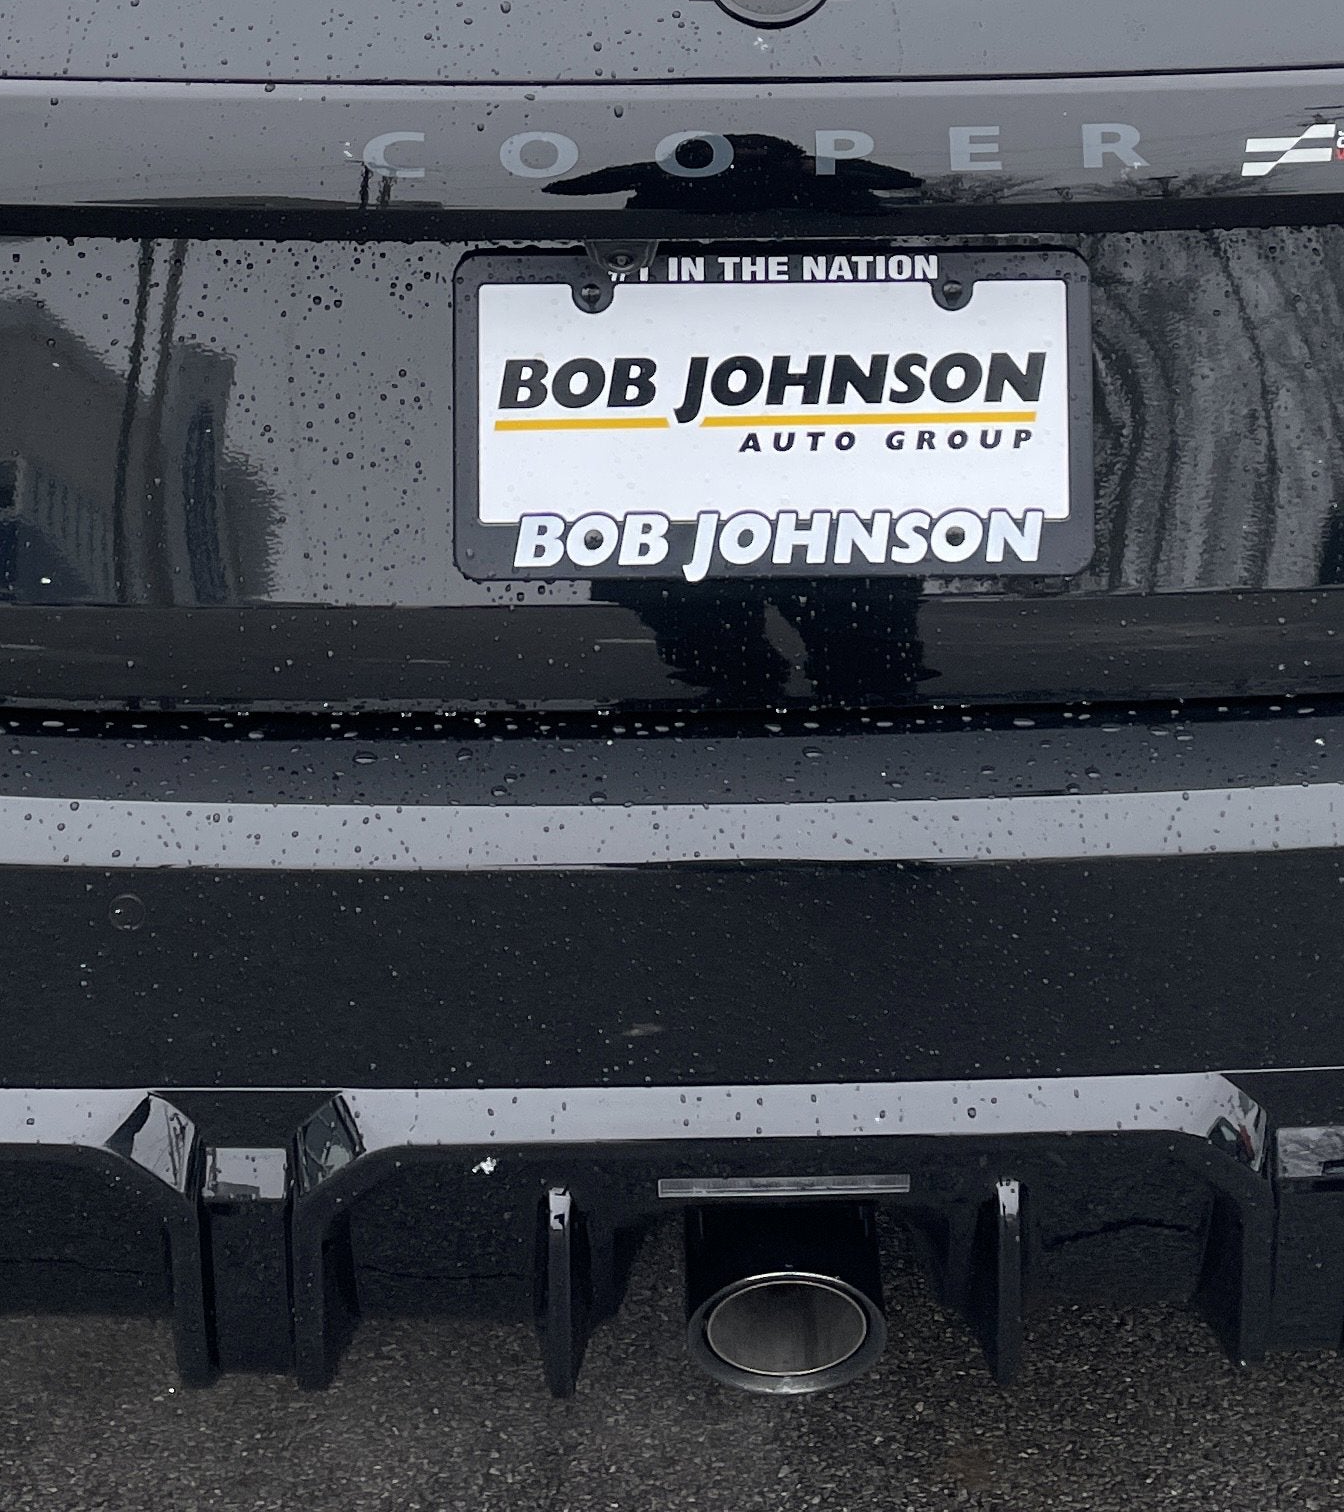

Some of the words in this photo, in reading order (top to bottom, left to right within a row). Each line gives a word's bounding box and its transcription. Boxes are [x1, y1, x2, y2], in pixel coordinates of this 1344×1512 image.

[362, 122, 1150, 179] COOPER
[667, 256, 706, 282] IN
[717, 256, 790, 282] THE
[802, 254, 939, 281] NATION
[498, 357, 657, 409] BOB
[674, 352, 1047, 424] JOHNSON
[739, 430, 856, 453] AUTO
[885, 429, 1034, 452] GROUP
[513, 510, 670, 568] BOB
[682, 509, 1045, 582] JOHNSON
